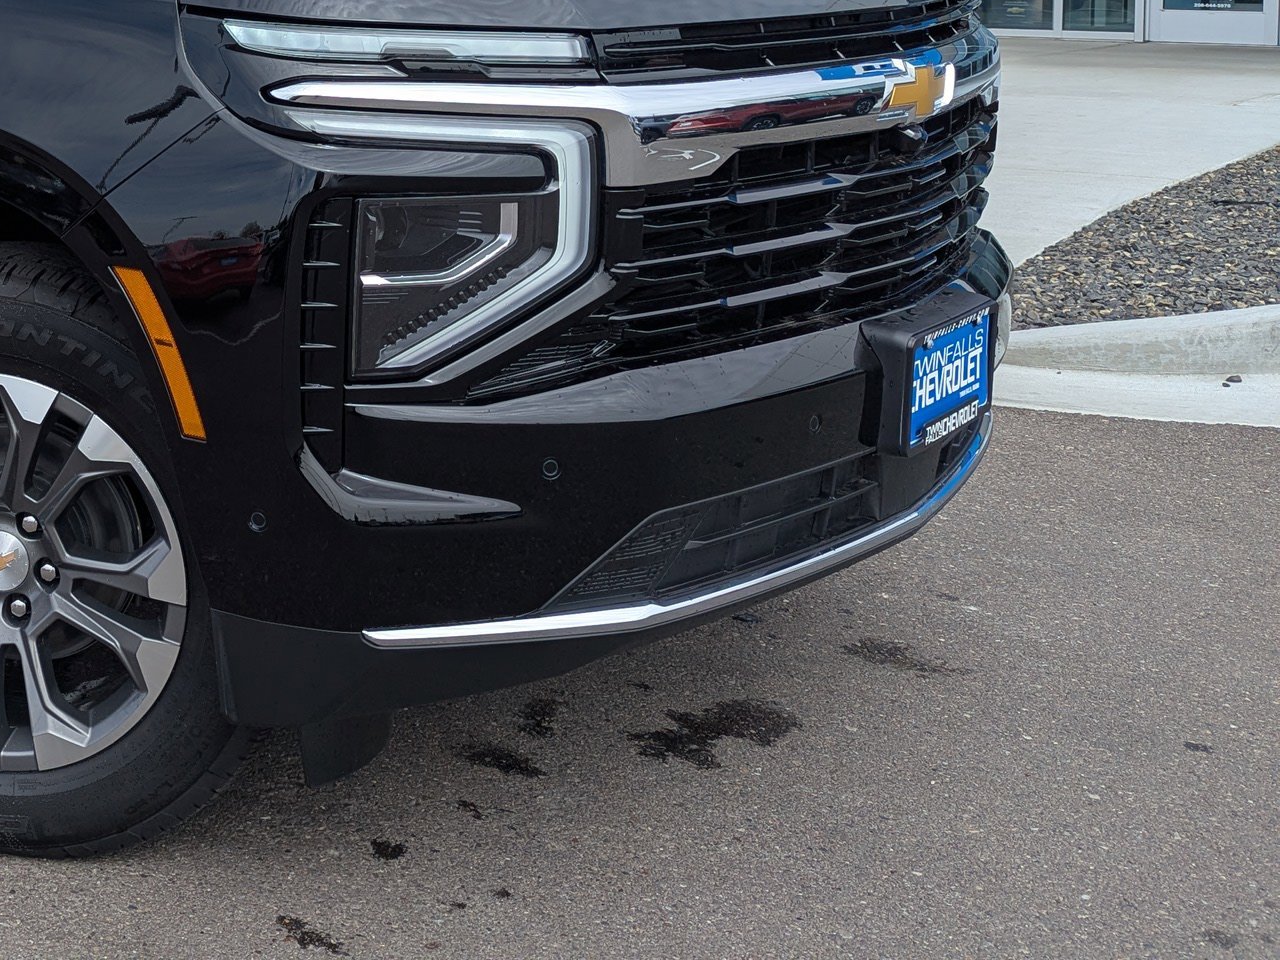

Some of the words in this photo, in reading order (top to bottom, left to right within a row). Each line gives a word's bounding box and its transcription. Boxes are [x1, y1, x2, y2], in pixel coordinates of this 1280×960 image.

[942, 399, 980, 436] CHEVROLET
[926, 420, 942, 437] TWIN
[925, 429, 943, 446] FALLS
